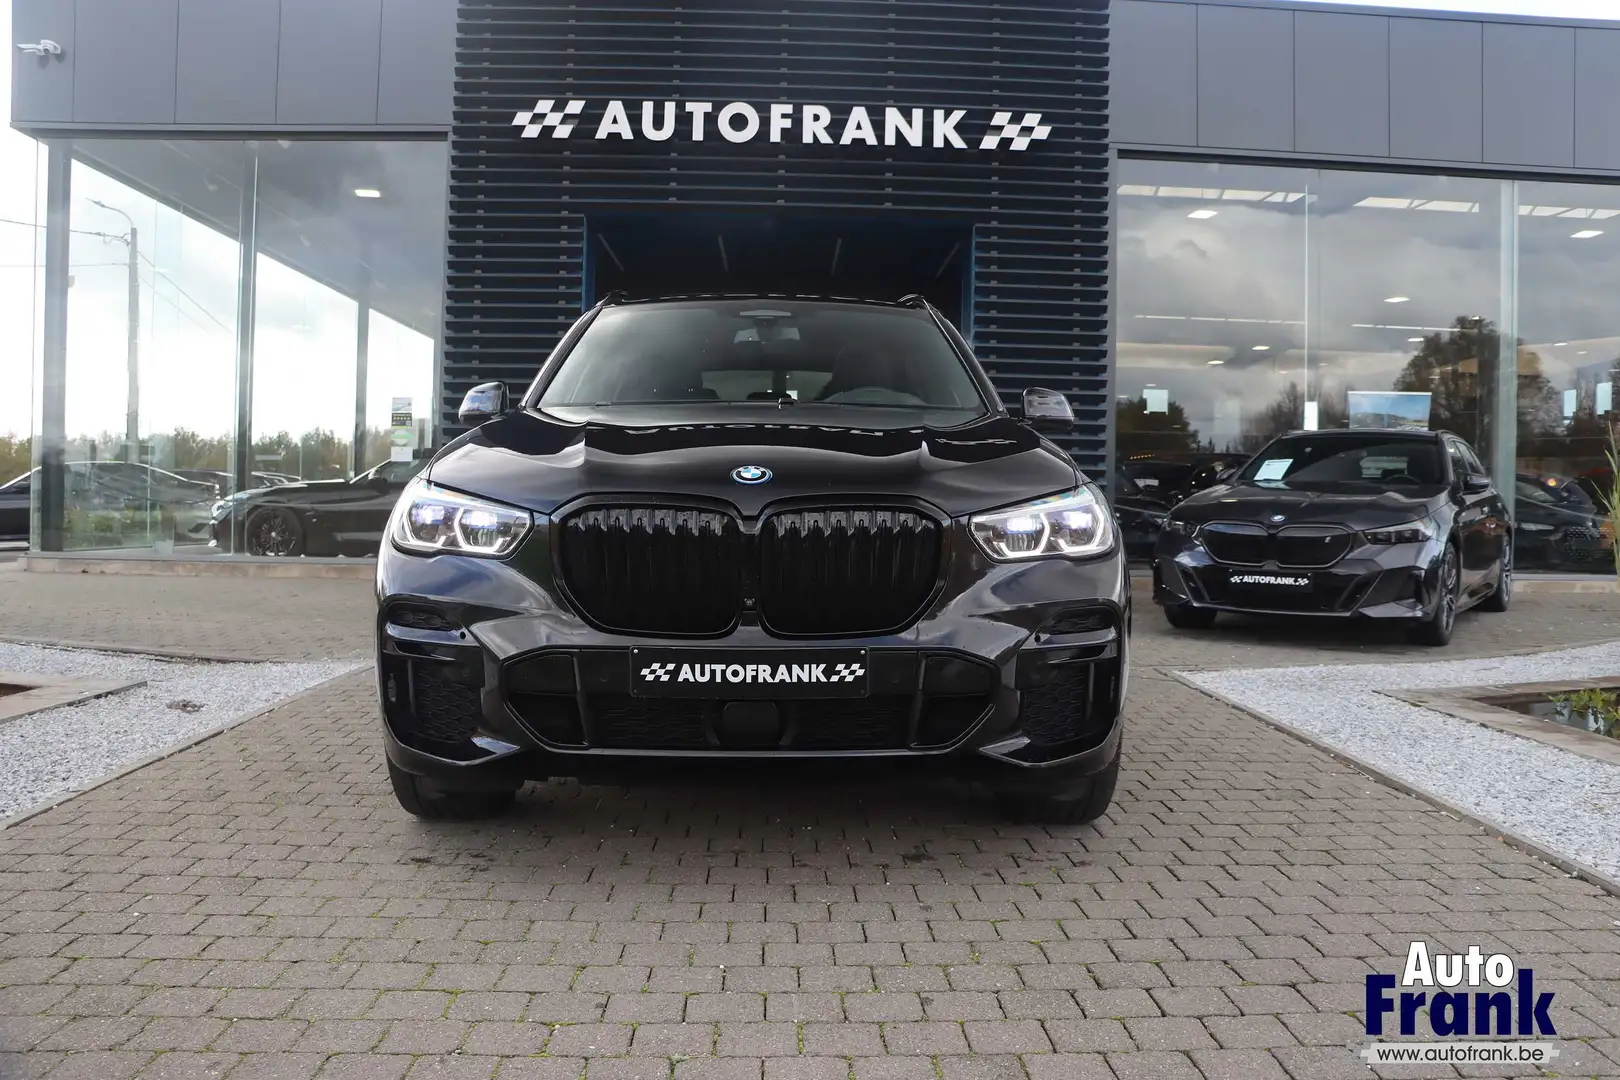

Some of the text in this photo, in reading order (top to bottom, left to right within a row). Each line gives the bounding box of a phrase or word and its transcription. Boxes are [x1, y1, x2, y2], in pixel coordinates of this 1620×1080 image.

[595, 101, 968, 149] AUTOFRANK
[1242, 575, 1295, 585] AUTOFRANK
[677, 664, 827, 683] AUTOFRANK
